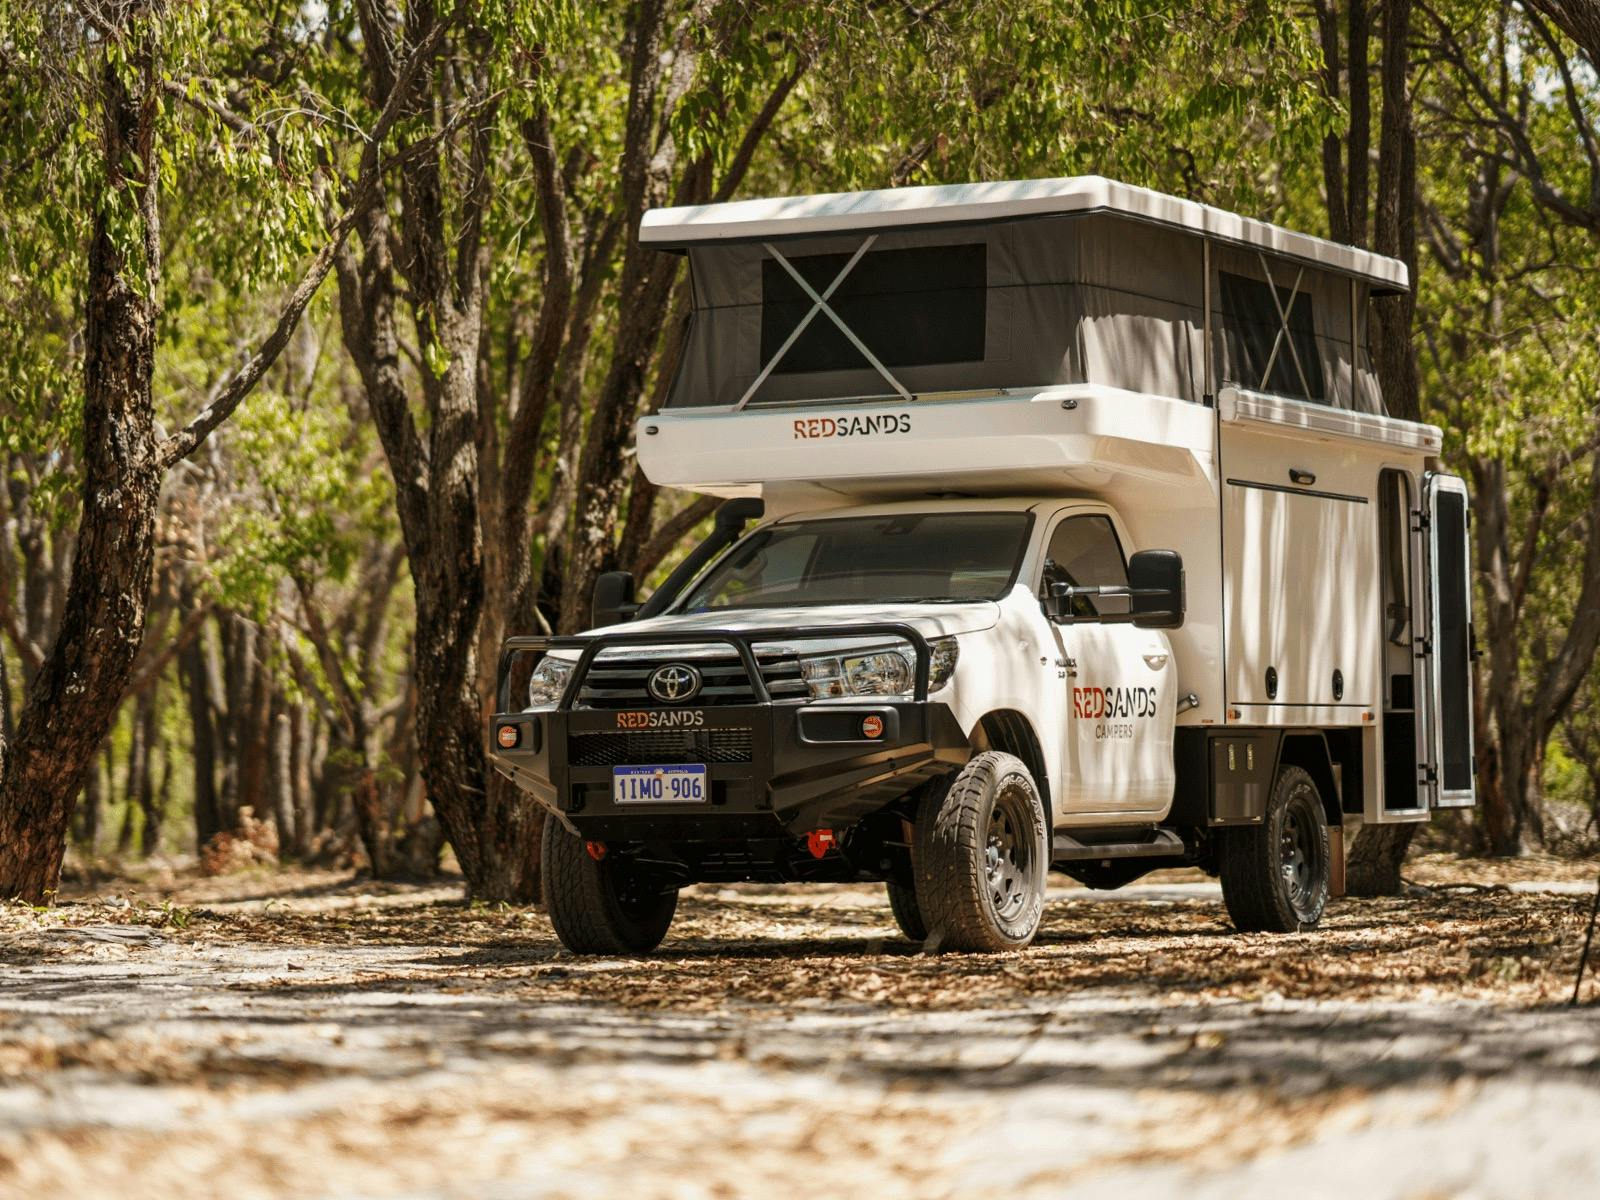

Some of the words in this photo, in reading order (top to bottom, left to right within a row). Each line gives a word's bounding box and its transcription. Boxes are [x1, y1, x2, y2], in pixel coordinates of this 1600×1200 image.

[794, 414, 911, 439] REDSANDS
[1073, 687, 1157, 719] REDSANDS
[617, 711, 704, 728] REDSANDS
[1096, 724, 1133, 739] CAMPERS
